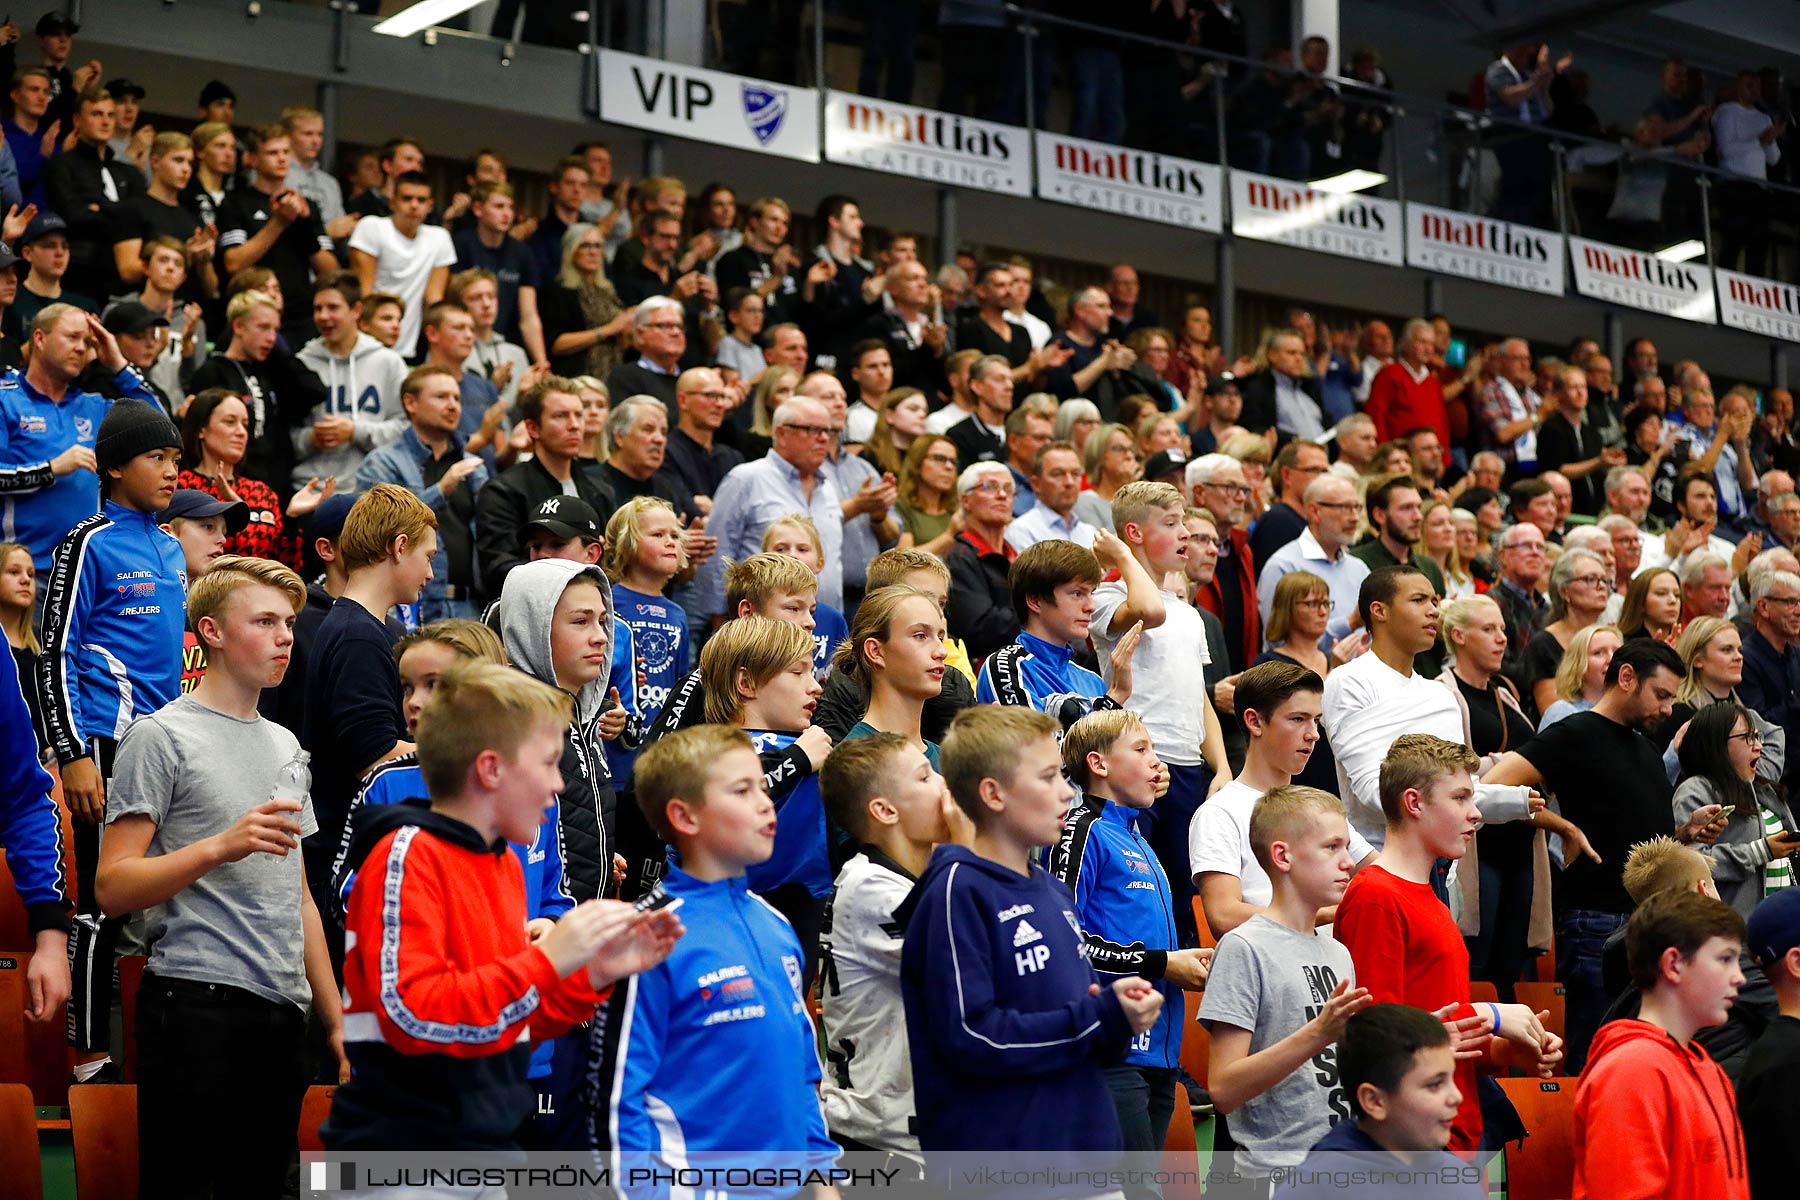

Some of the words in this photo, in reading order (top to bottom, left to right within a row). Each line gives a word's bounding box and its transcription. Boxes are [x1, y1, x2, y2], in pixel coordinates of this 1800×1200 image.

[631, 66, 713, 121] VIP
[847, 104, 1010, 160] mattias
[861, 148, 998, 190] CATERING
[1055, 144, 1204, 197] mattias
[1069, 183, 1194, 227] CATERING
[1423, 213, 1547, 261] mattias
[1433, 253, 1538, 290] CATERING
[1584, 247, 1698, 292] mattias
[1600, 281, 1688, 317] CATERIN
[125, 605, 160, 616] REJLERS
[1014, 944, 1051, 977] HP
[538, 1093, 555, 1114] LL
